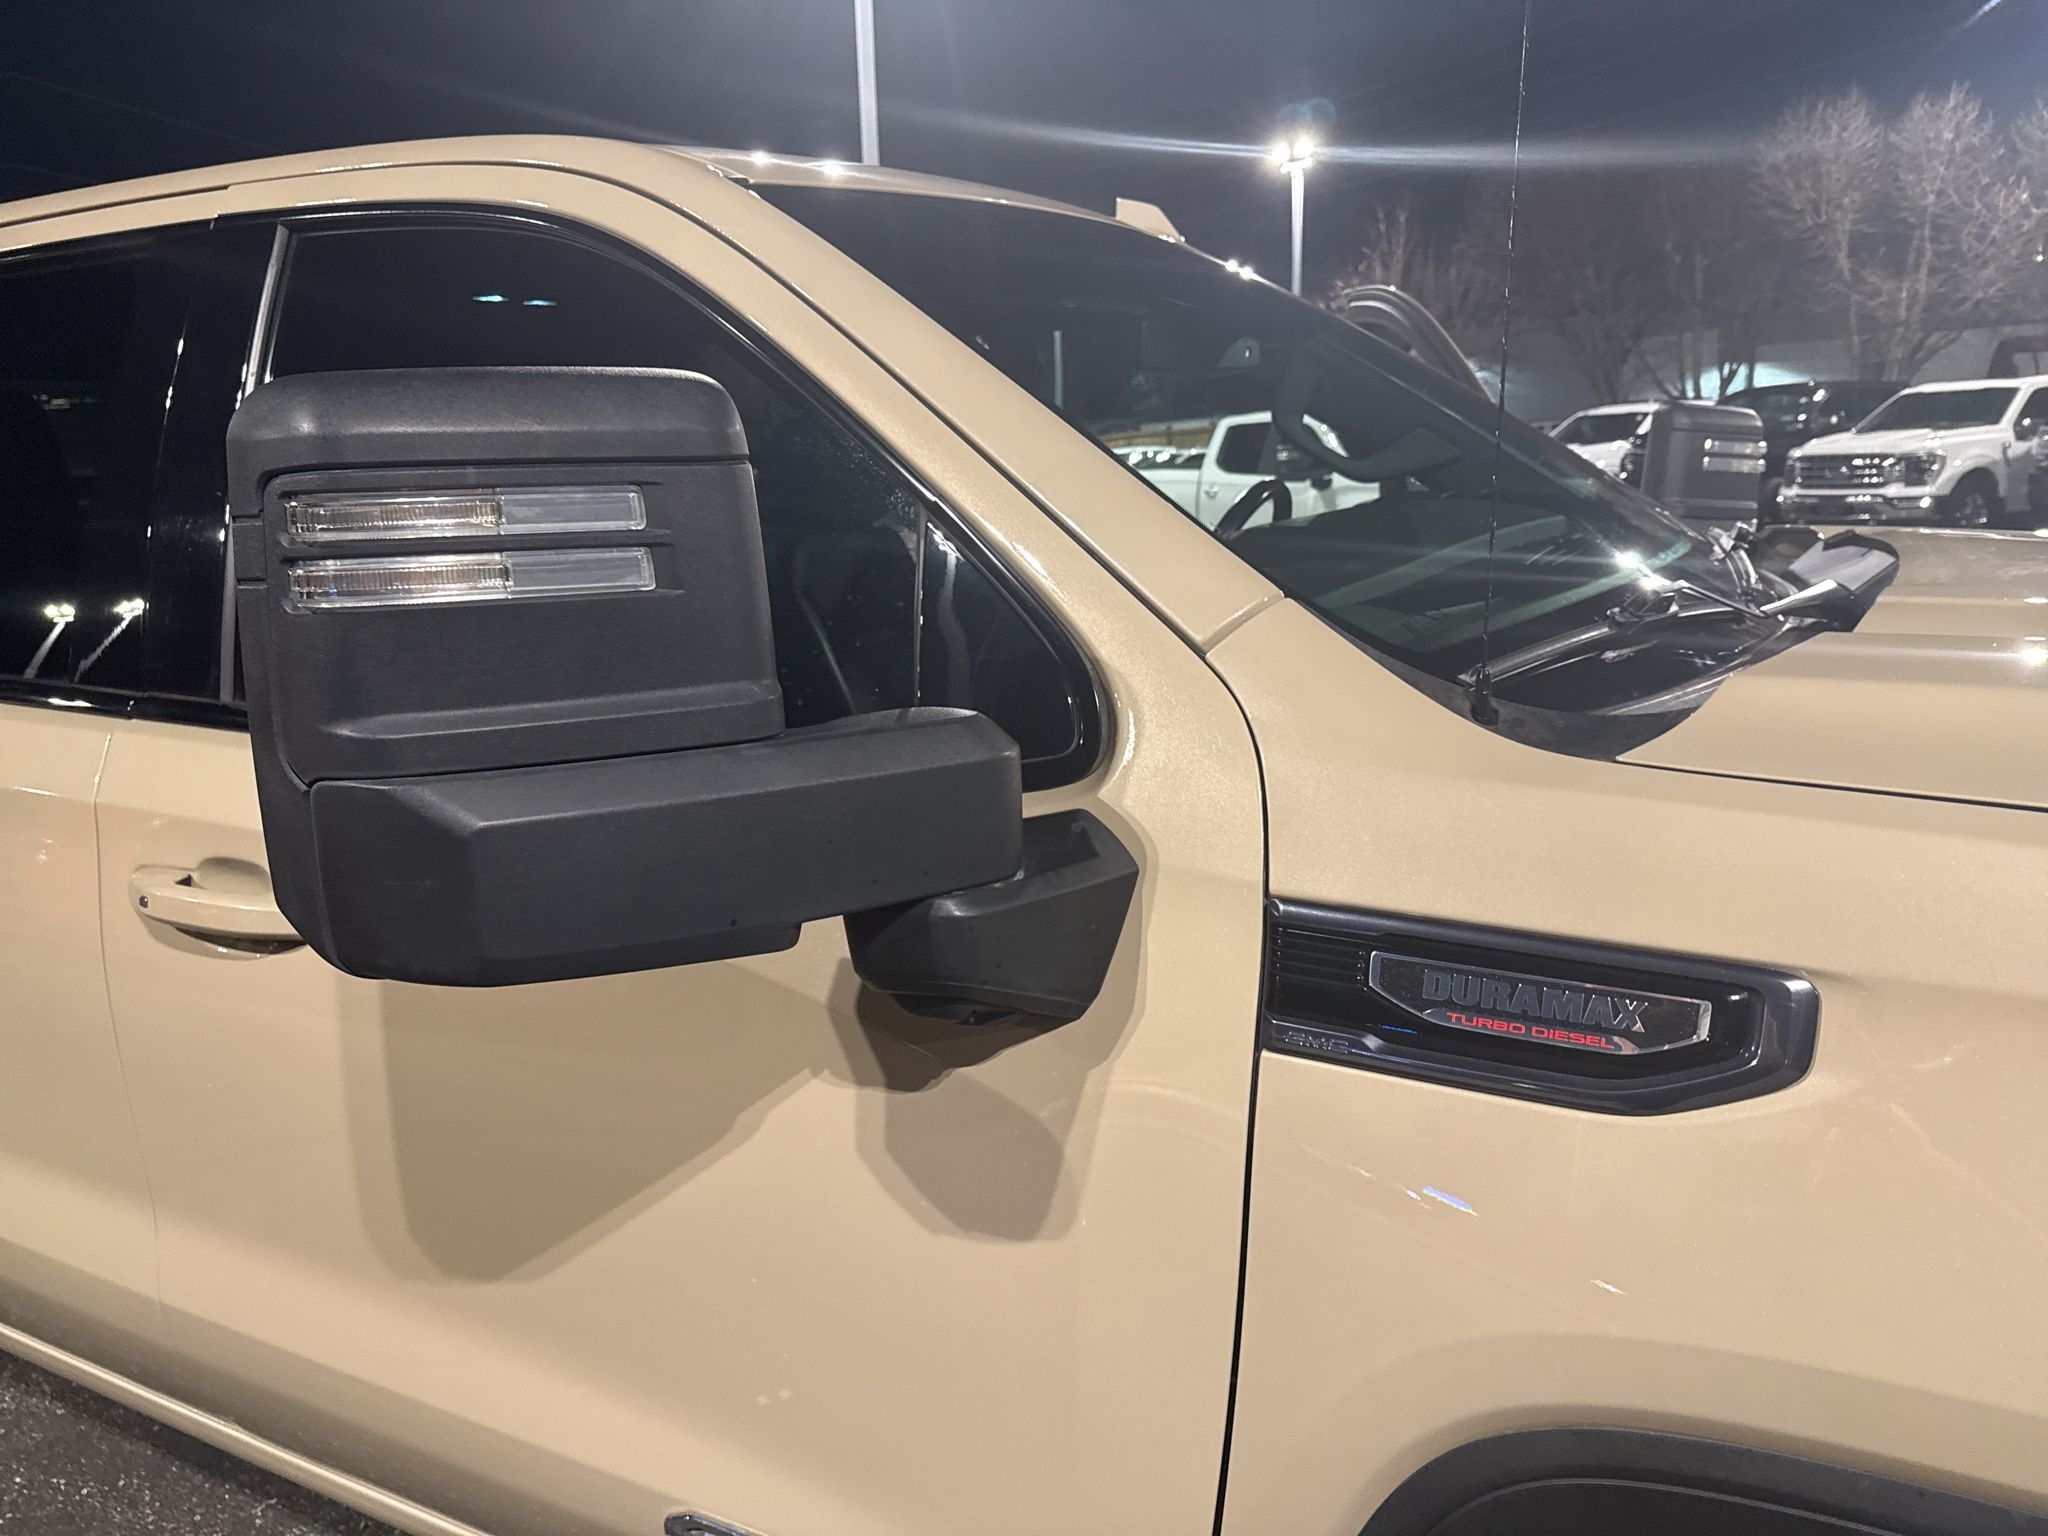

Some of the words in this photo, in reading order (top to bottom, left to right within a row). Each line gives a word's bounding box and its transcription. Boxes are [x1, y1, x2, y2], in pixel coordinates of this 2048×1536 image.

[1422, 968, 1649, 1033] DURAMAX
[1446, 1012, 1526, 1034] TURBO
[1532, 1027, 1615, 1050] DIESEL
